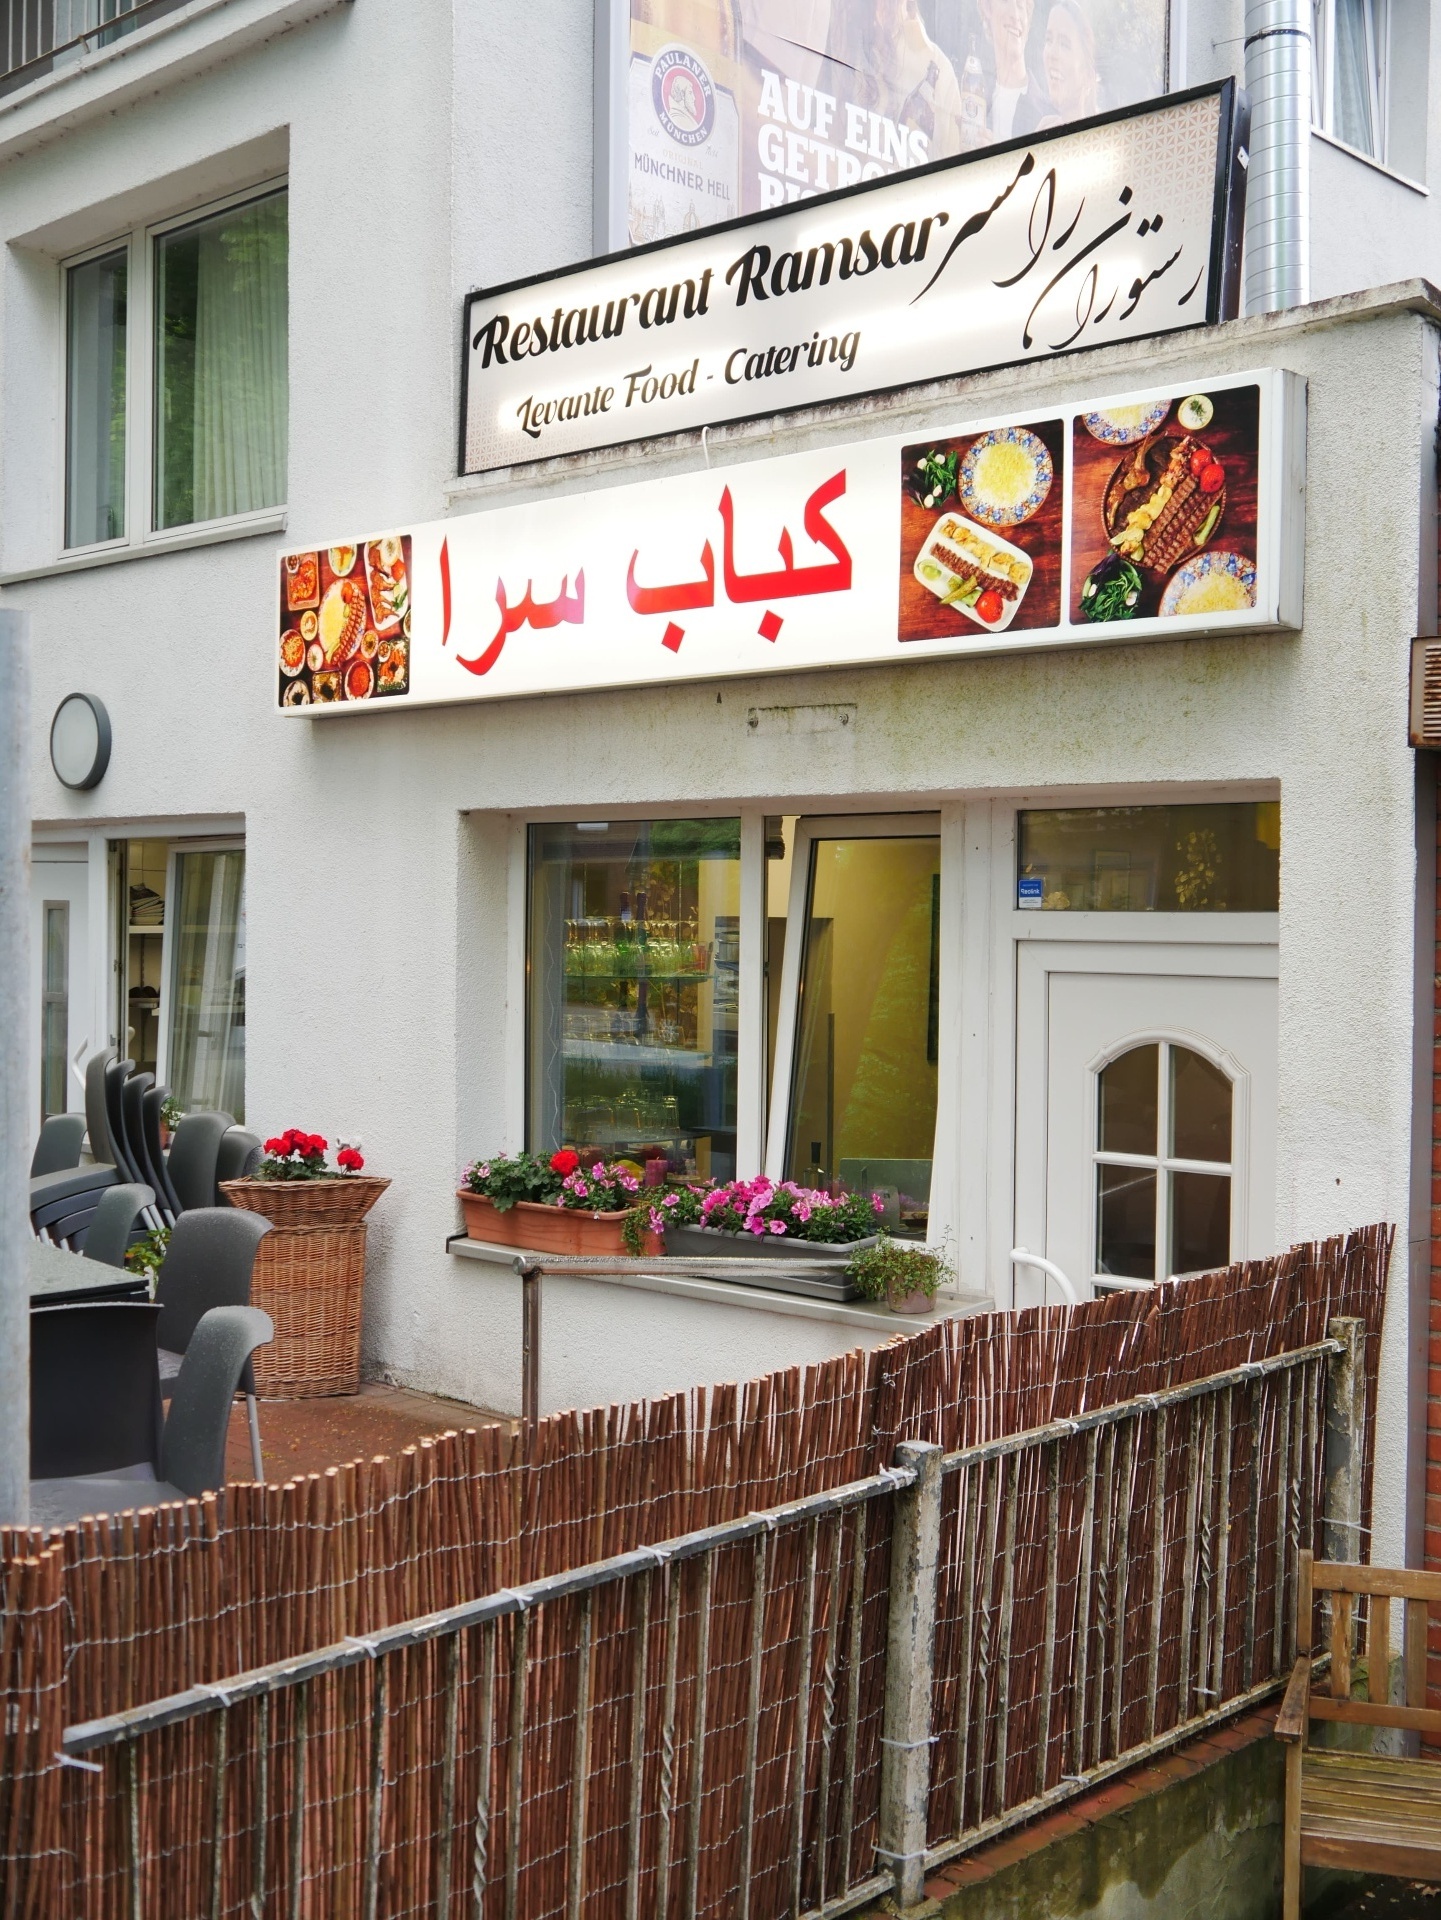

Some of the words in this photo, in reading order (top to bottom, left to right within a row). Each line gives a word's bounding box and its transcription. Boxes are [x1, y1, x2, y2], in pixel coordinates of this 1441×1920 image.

[654, 52, 712, 97] PAULANER
[658, 111, 709, 144] MÜNCHEN
[757, 68, 836, 140] AUF
[844, 101, 930, 170] EINS
[634, 152, 705, 192] MÜNCHNER
[707, 178, 731, 201] HELL
[472, 267, 716, 369] Restaurant
[725, 211, 949, 307] Ramsar
[516, 381, 615, 439] Levante
[623, 358, 701, 408] Food
[723, 328, 862, 372] Catering
[439, 534, 586, 677] سرا
[626, 469, 853, 653] کباب
